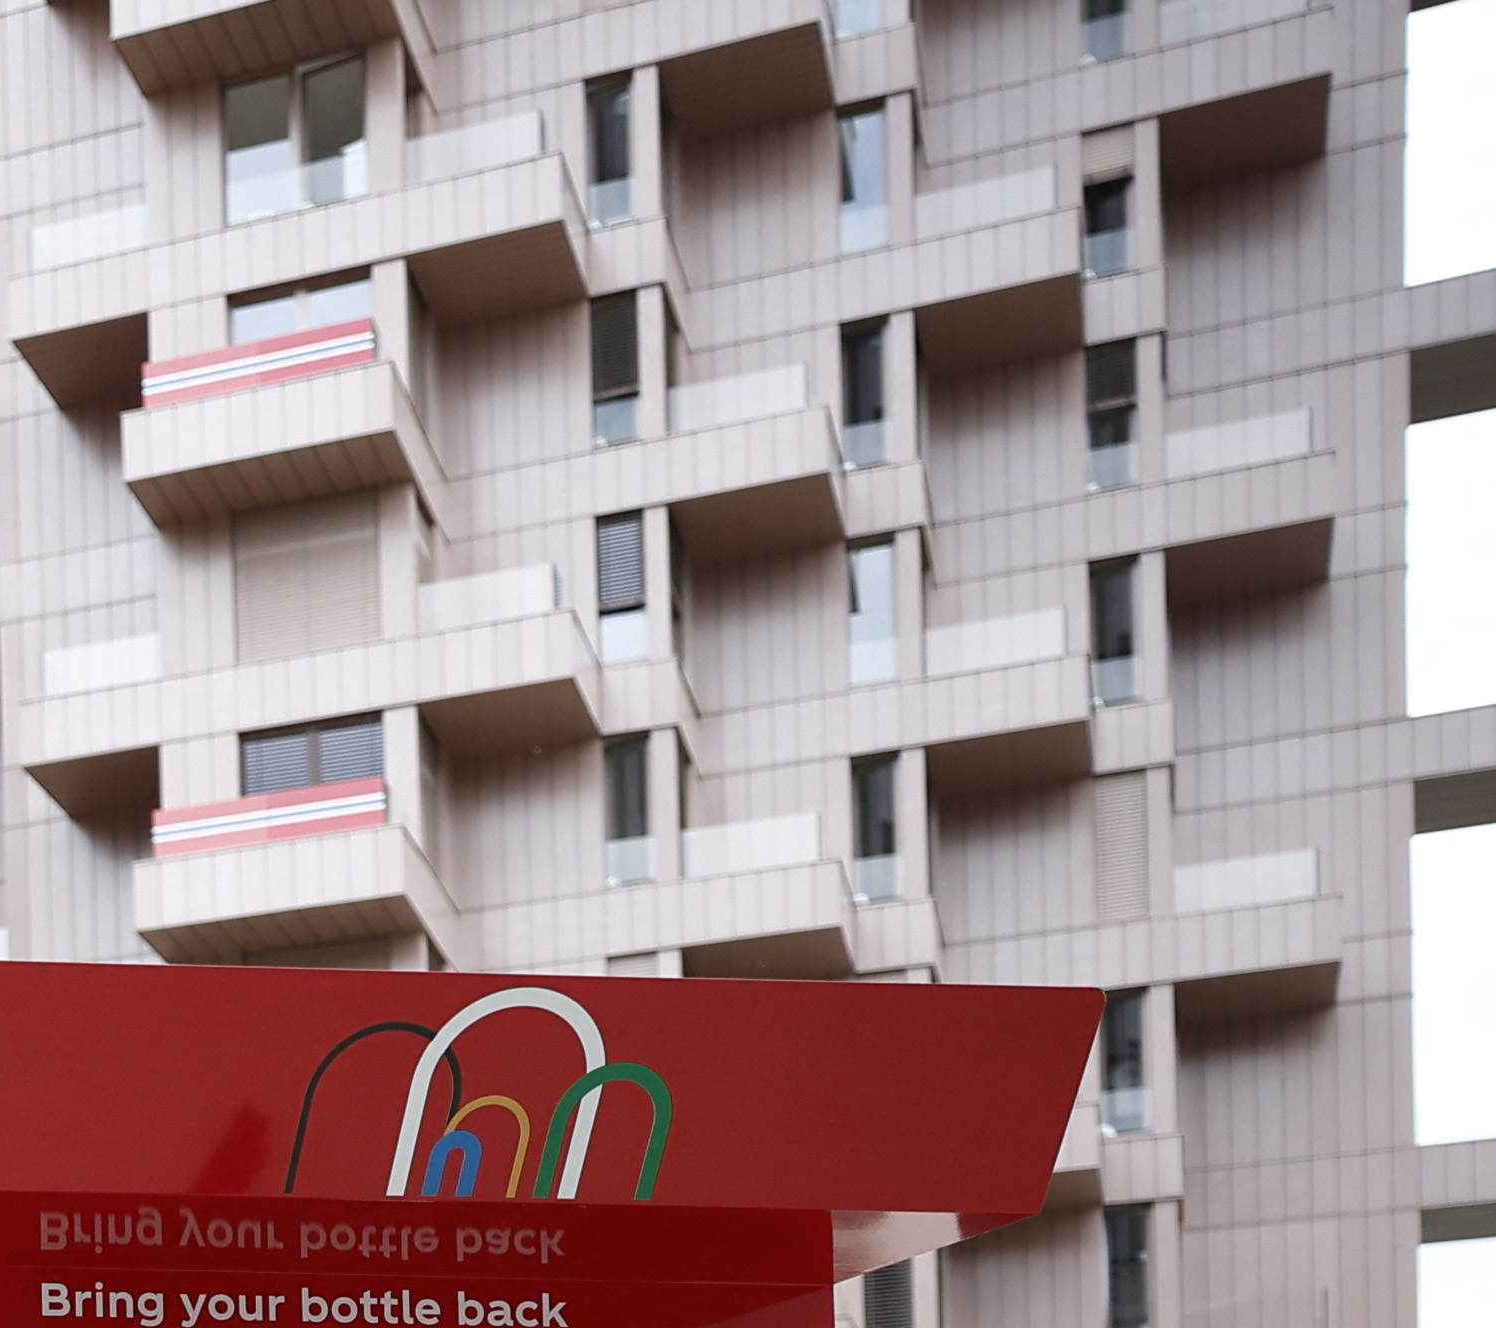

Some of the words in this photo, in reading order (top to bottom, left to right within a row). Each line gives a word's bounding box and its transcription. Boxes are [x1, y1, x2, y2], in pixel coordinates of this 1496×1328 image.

[41, 1281, 164, 1327] Bring
[179, 1293, 286, 1328] your
[301, 1287, 441, 1326] bottle
[457, 1290, 569, 1328] back
